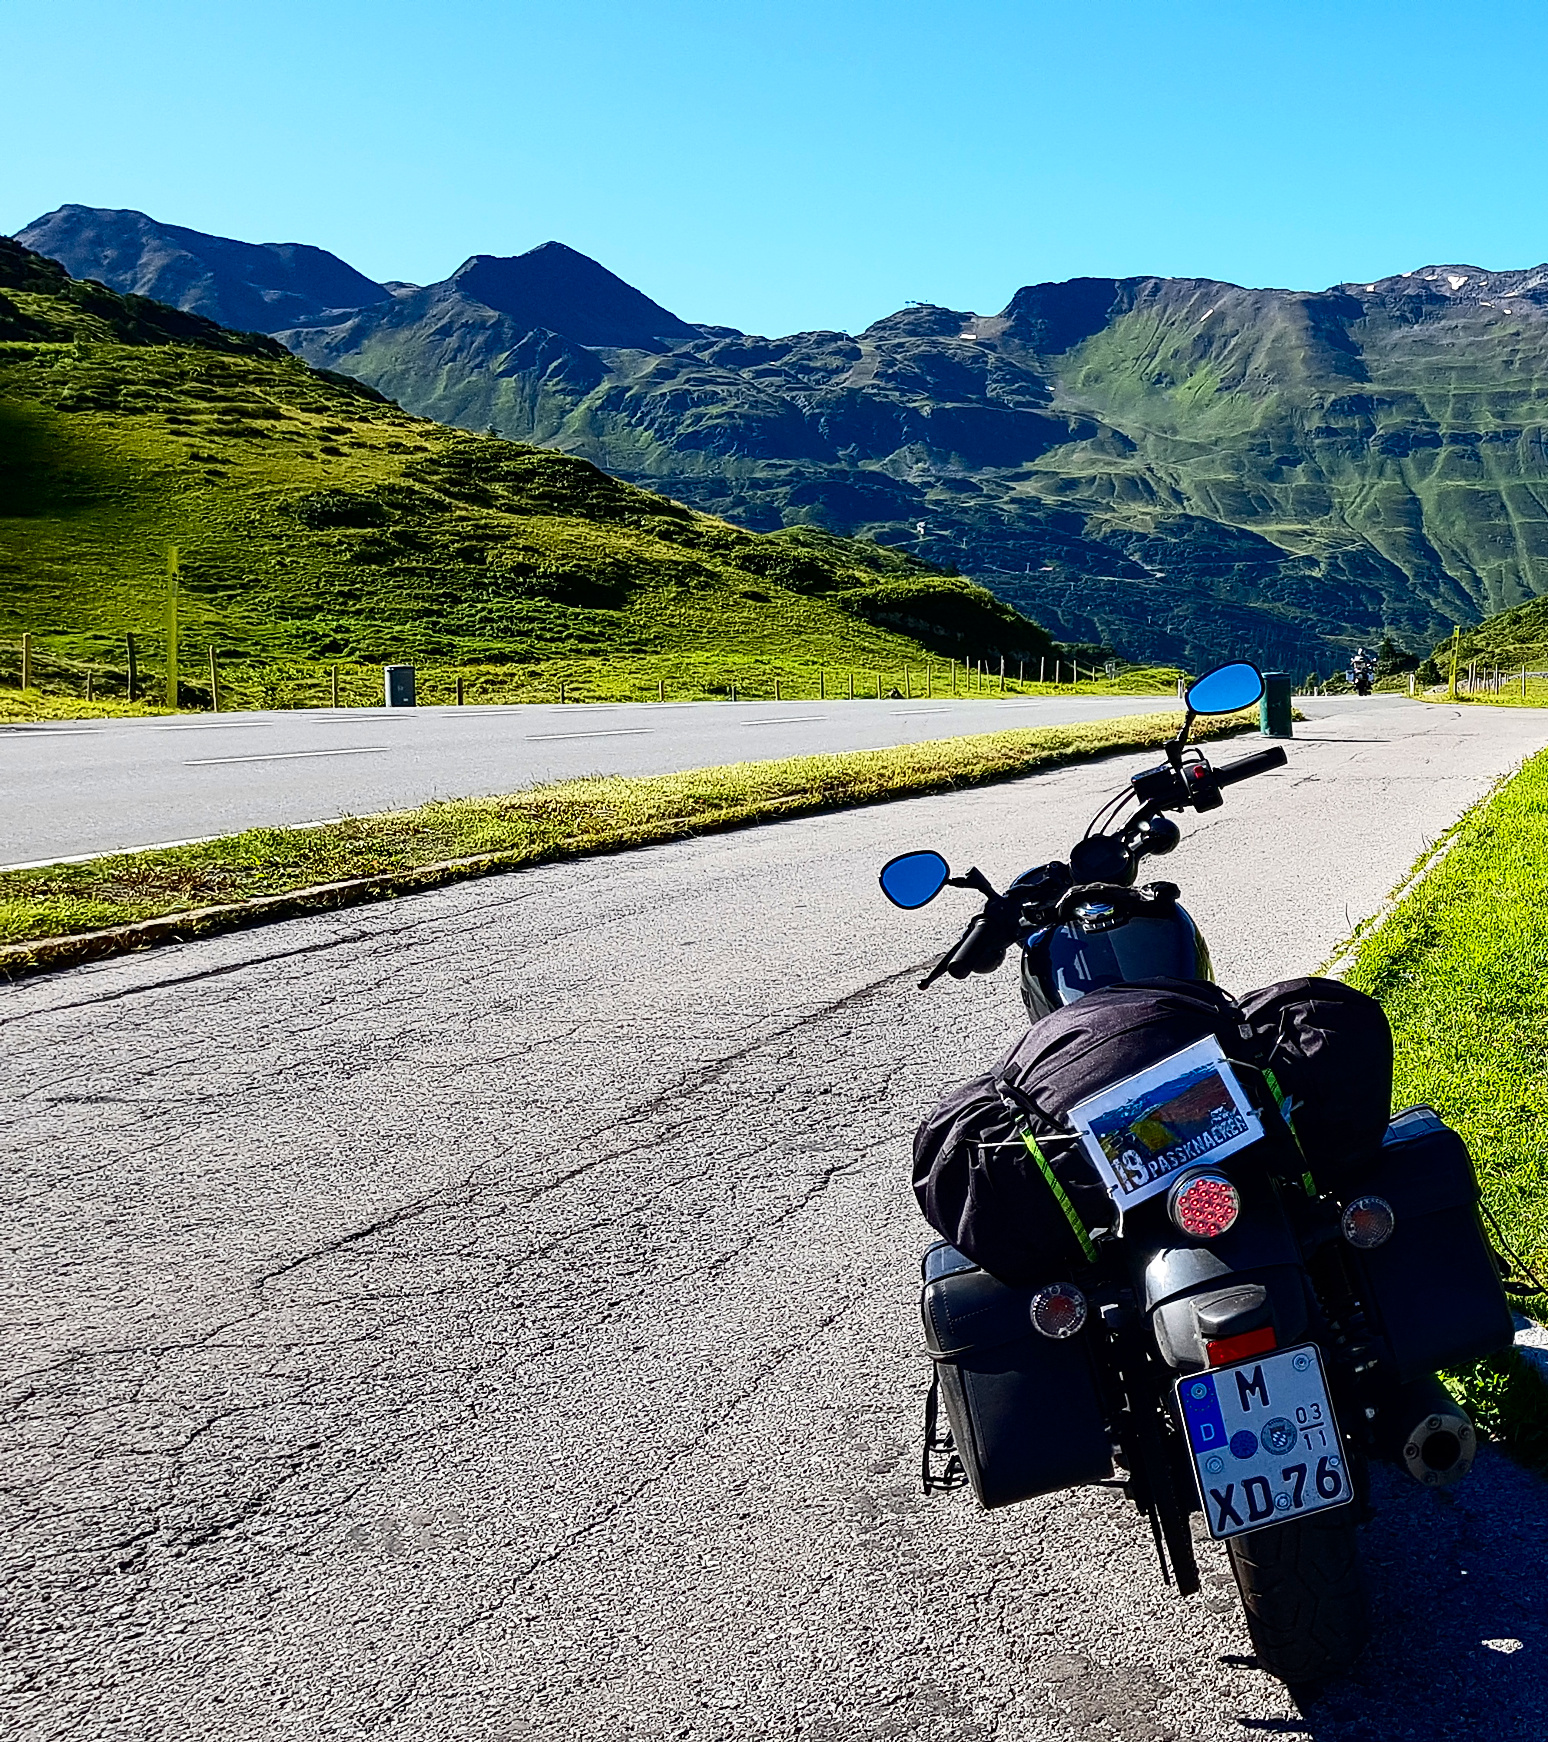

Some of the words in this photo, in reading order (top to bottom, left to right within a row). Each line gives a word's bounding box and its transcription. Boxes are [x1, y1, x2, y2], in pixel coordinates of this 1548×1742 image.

[1149, 1114, 1249, 1178] PASSKNACKER
[1234, 1364, 1270, 1413] M
[1295, 1402, 1322, 1424] 03
[1200, 1422, 1215, 1442] D
[1303, 1429, 1327, 1451] 11
